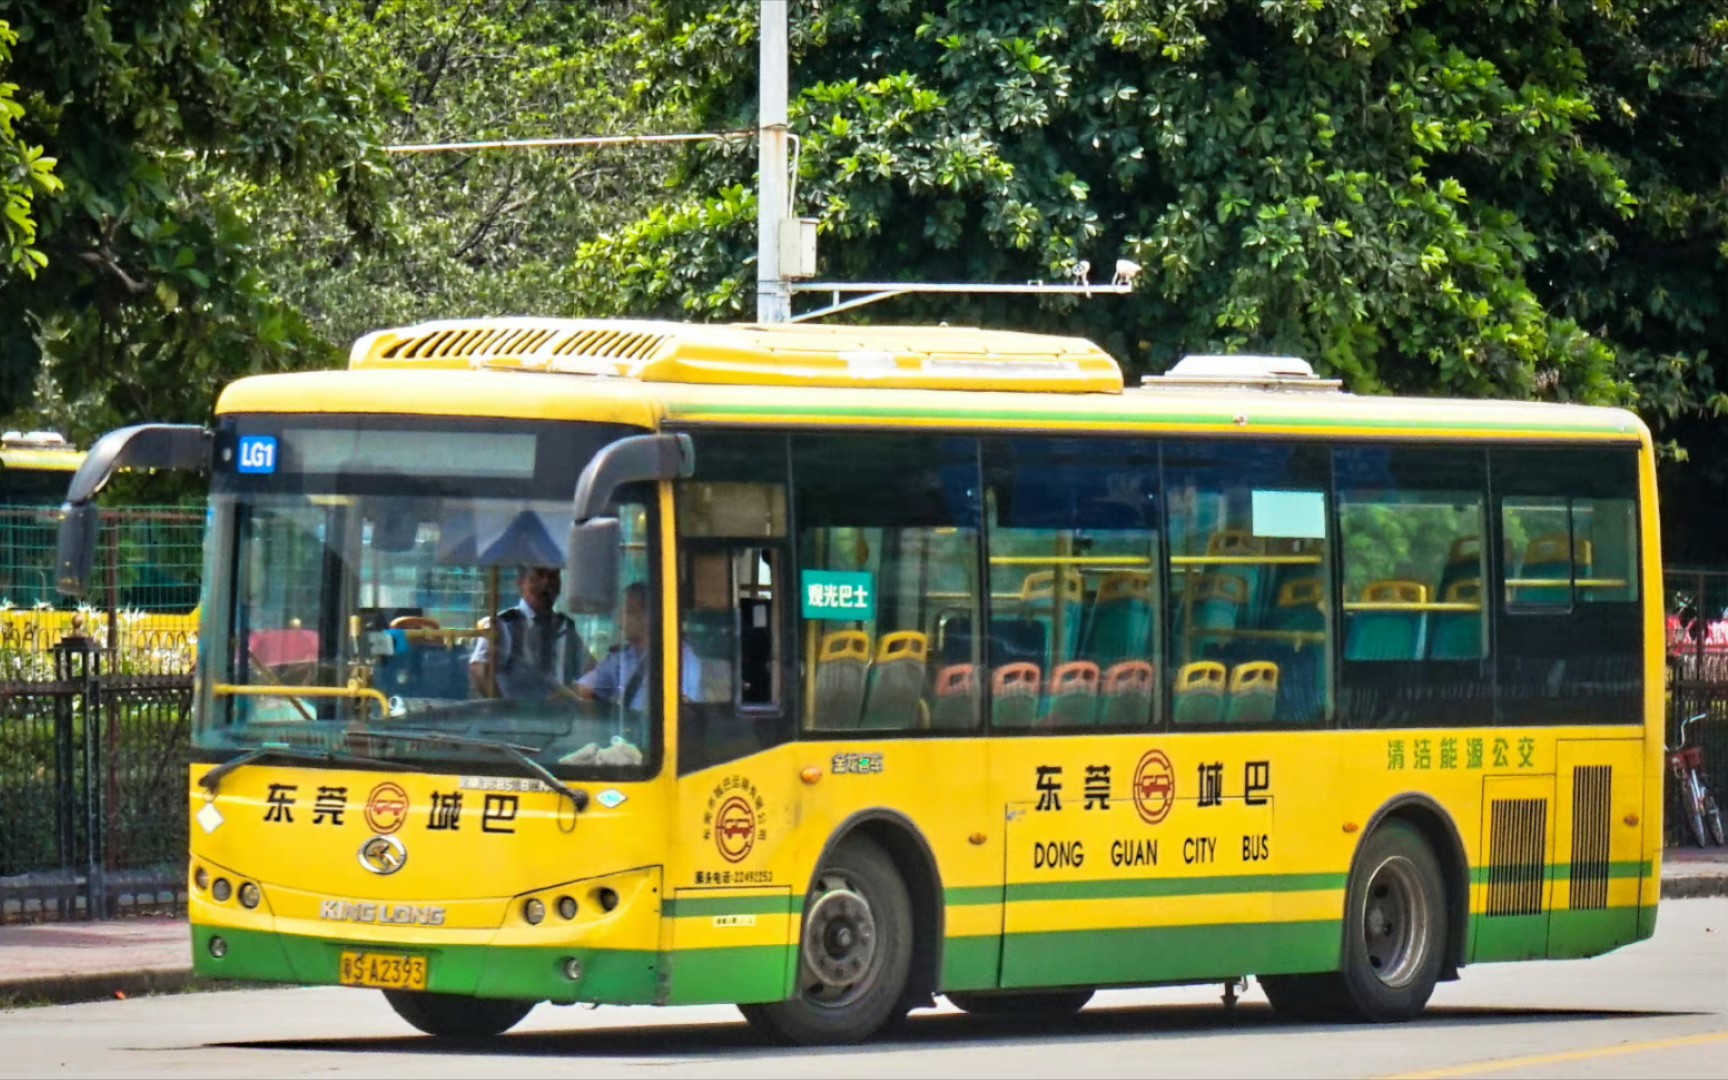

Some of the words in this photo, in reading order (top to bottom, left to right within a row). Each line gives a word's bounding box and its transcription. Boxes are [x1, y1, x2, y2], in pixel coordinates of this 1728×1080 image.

[241, 441, 273, 467] LG1
[807, 583, 869, 608] 观光巴士
[1387, 736, 1535, 770] 清洁能源公交
[1035, 764, 1111, 811] 东莞
[1197, 761, 1270, 807] 城巴
[263, 783, 348, 826] 东莞
[426, 790, 520, 834] 城巴
[1034, 840, 1084, 869] DONG
[1110, 839, 1158, 867] GUAN
[1183, 836, 1217, 864] CITY
[1242, 834, 1269, 861] BUS
[320, 901, 377, 922] KING
[379, 904, 447, 926] LONG
